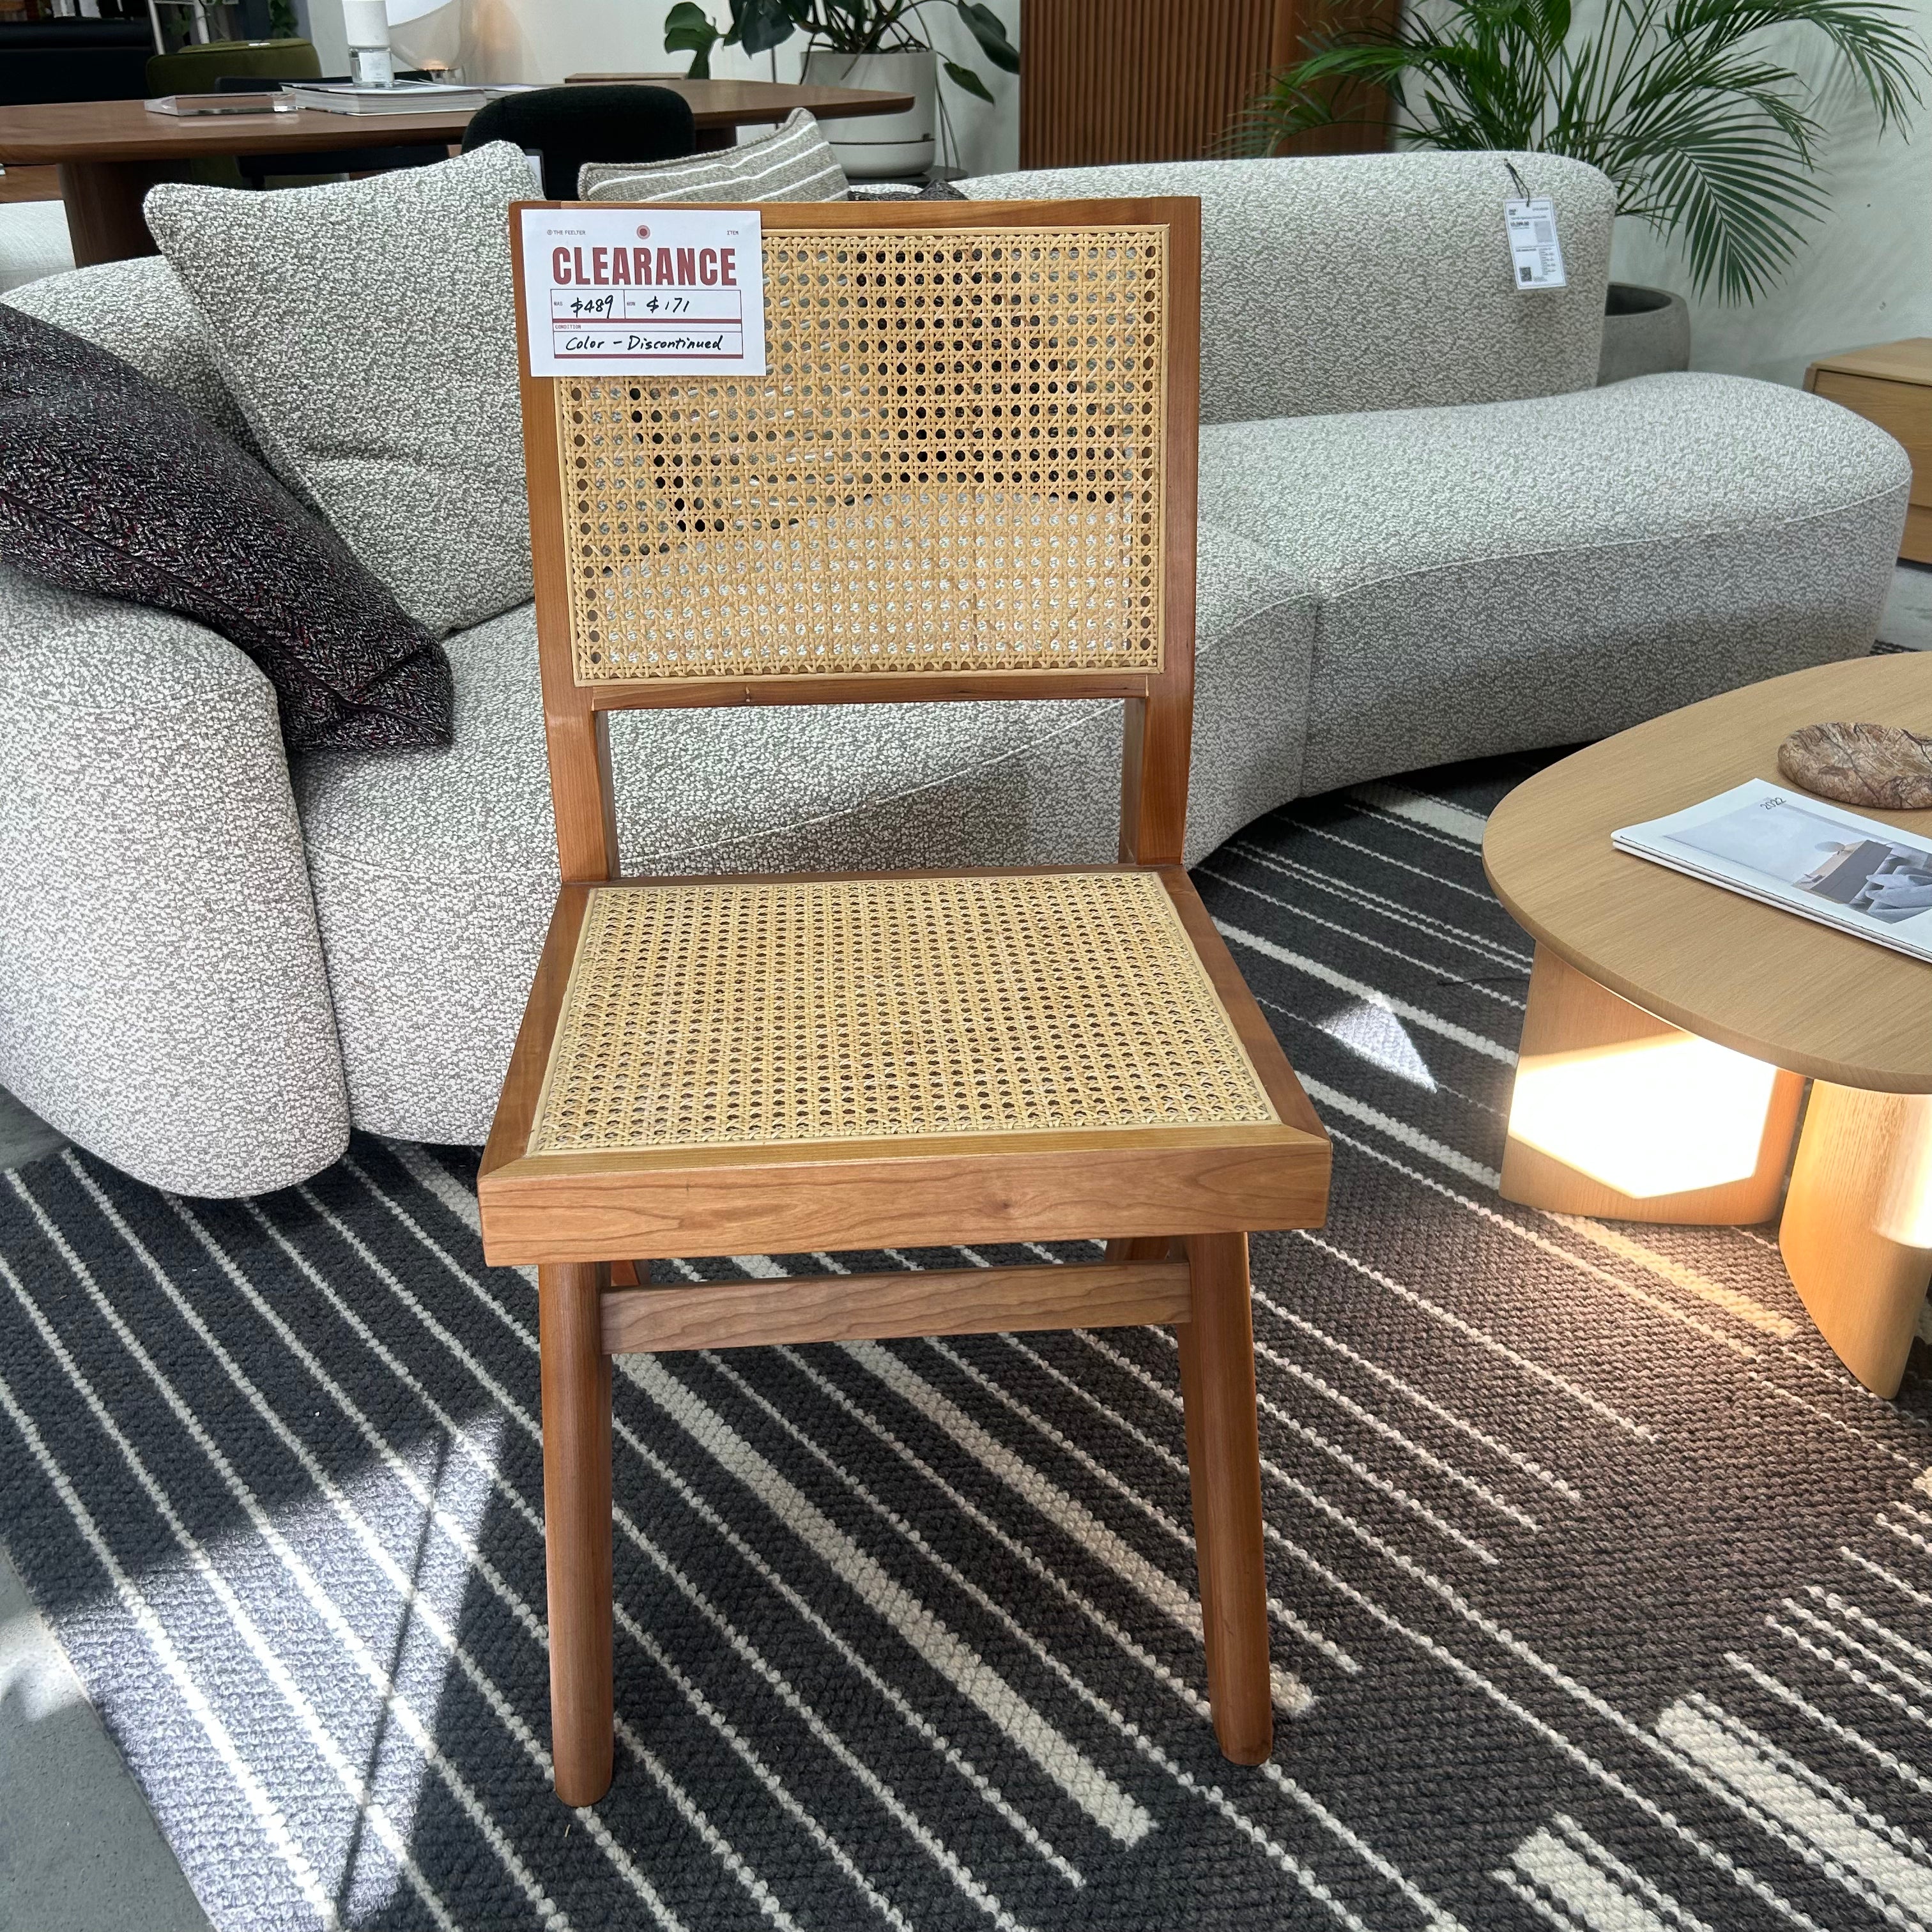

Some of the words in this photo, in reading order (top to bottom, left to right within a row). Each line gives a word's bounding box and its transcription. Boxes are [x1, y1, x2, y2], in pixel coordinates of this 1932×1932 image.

[552, 247, 737, 286] CLEARANCE
[571, 295, 613, 319] $489
[565, 335, 604, 350] Color
[627, 335, 723, 351] Discontinued
[1759, 797, 1786, 809] 2022
